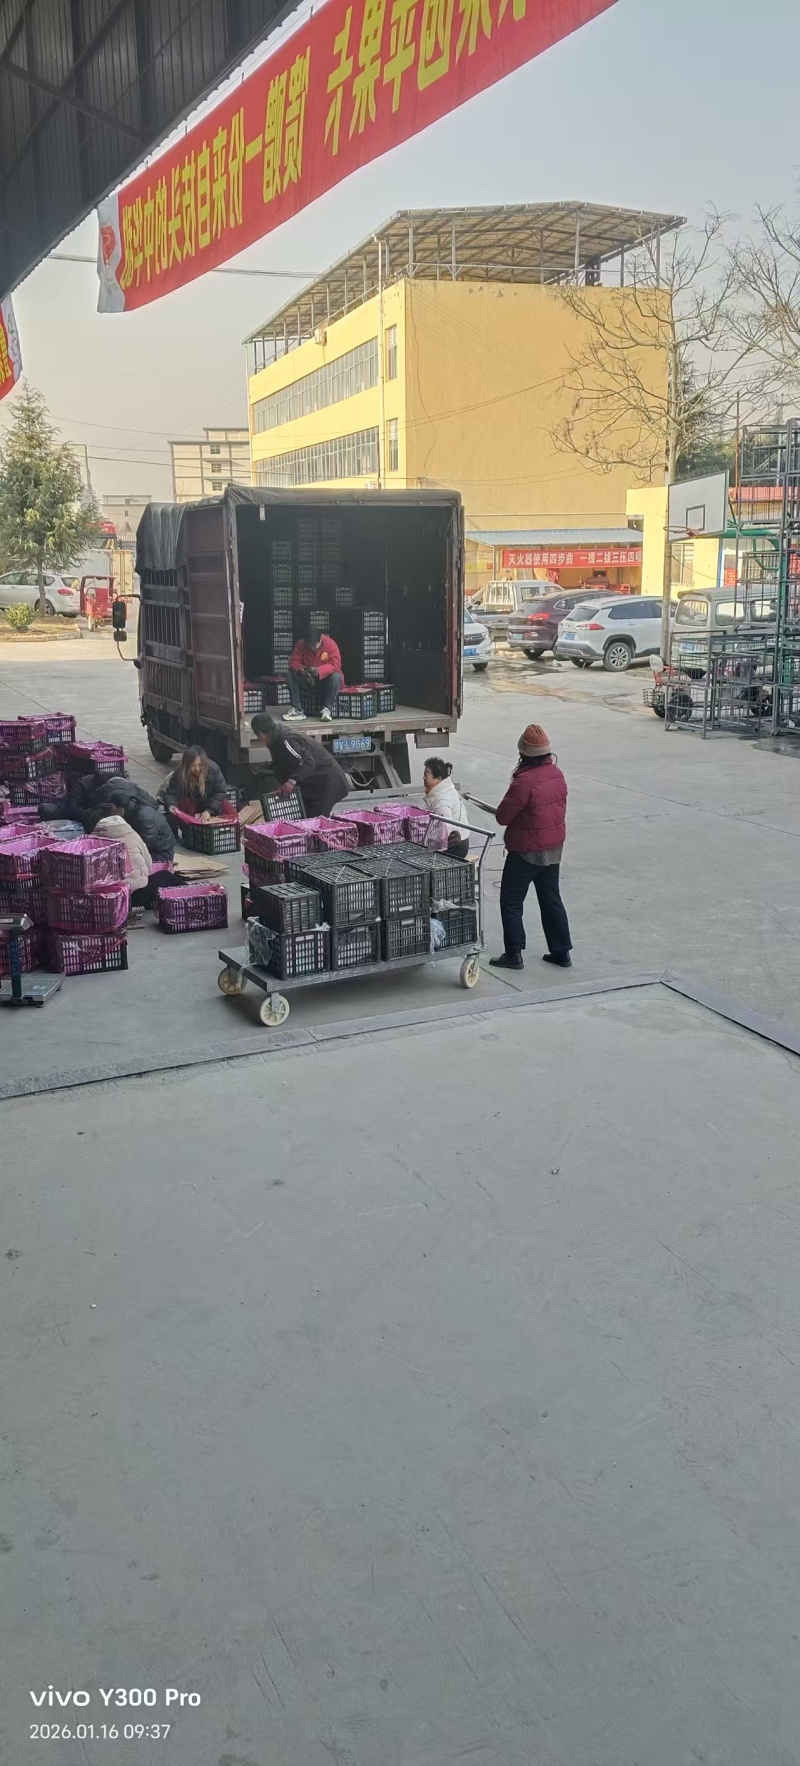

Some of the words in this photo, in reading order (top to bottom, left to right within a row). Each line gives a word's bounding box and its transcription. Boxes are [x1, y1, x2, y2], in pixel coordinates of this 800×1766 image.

[508, 553, 573, 565] 灭火器使用四步曲
